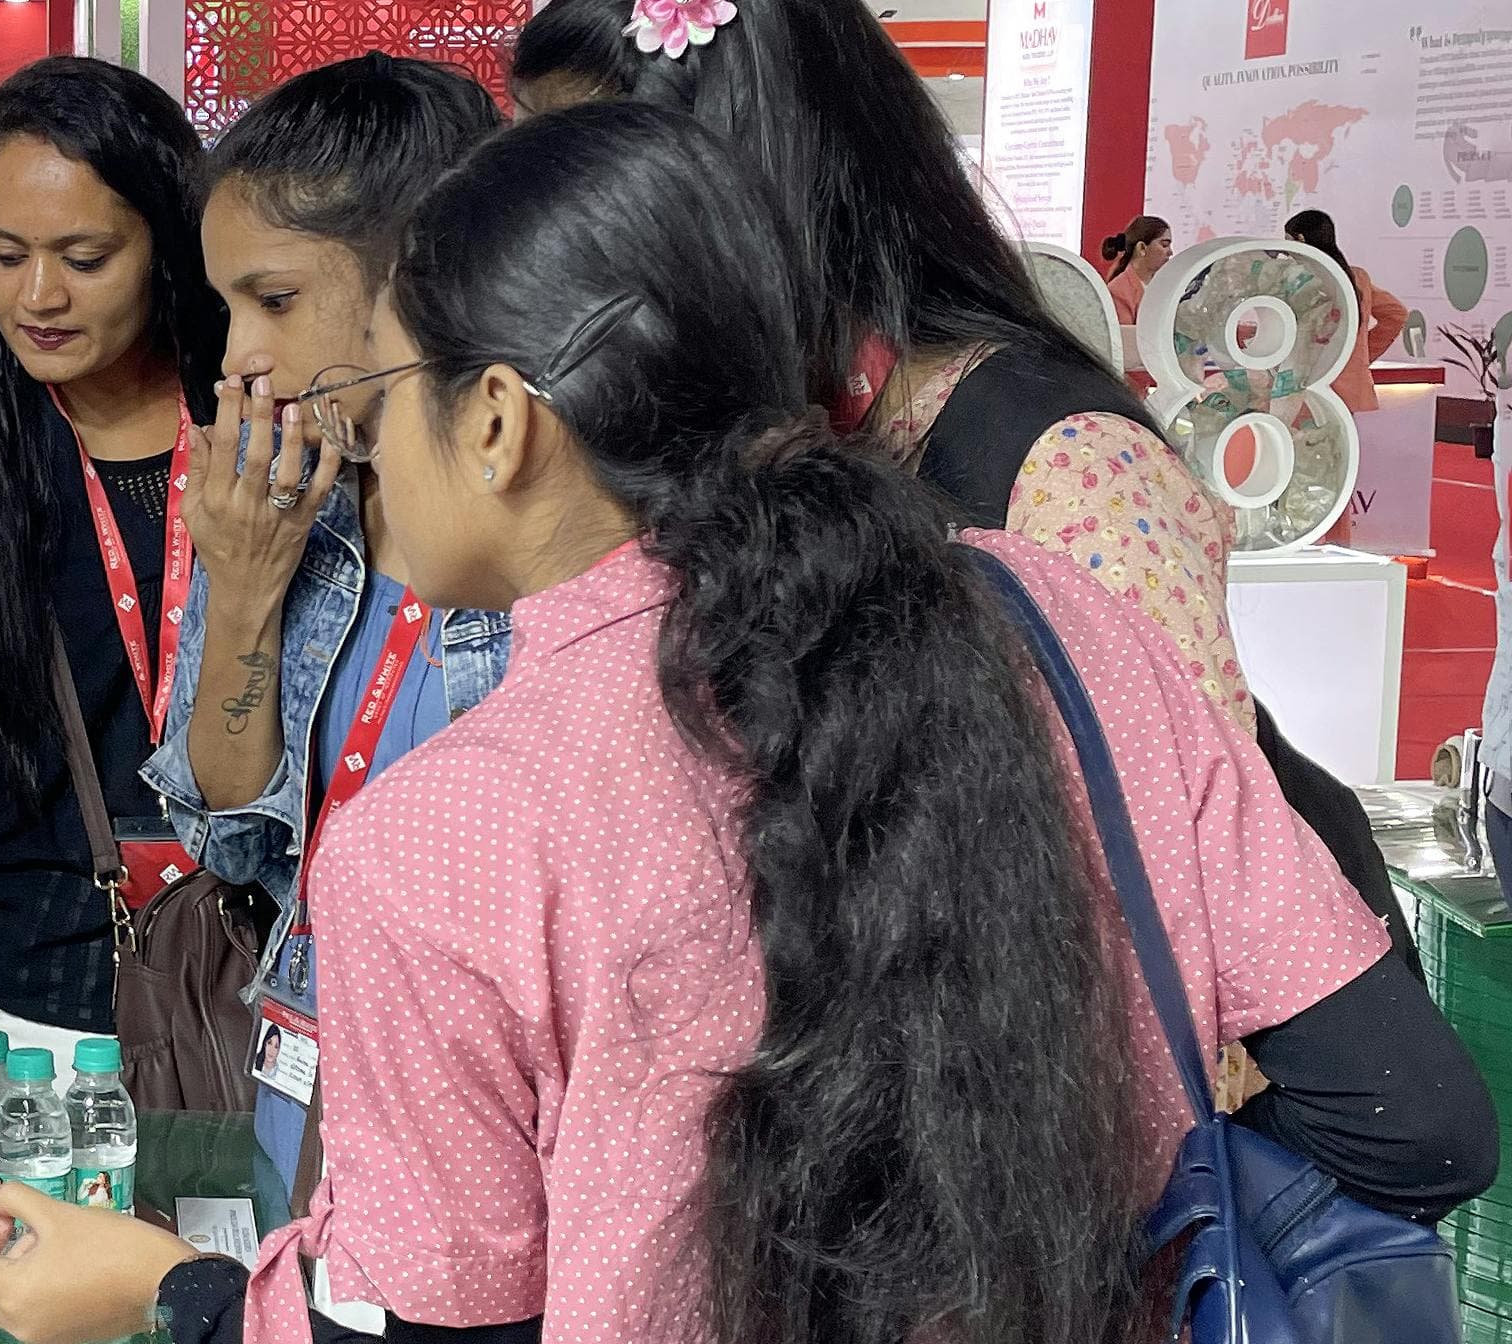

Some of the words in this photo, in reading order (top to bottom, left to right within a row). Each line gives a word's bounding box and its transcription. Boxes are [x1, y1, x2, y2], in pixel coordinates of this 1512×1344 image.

[107, 548, 119, 570] RED
[171, 548, 180, 558] &
[171, 559, 180, 580] RED
[375, 651, 398, 688] WHITE
[372, 686, 384, 700] &
[361, 699, 377, 724] RED
